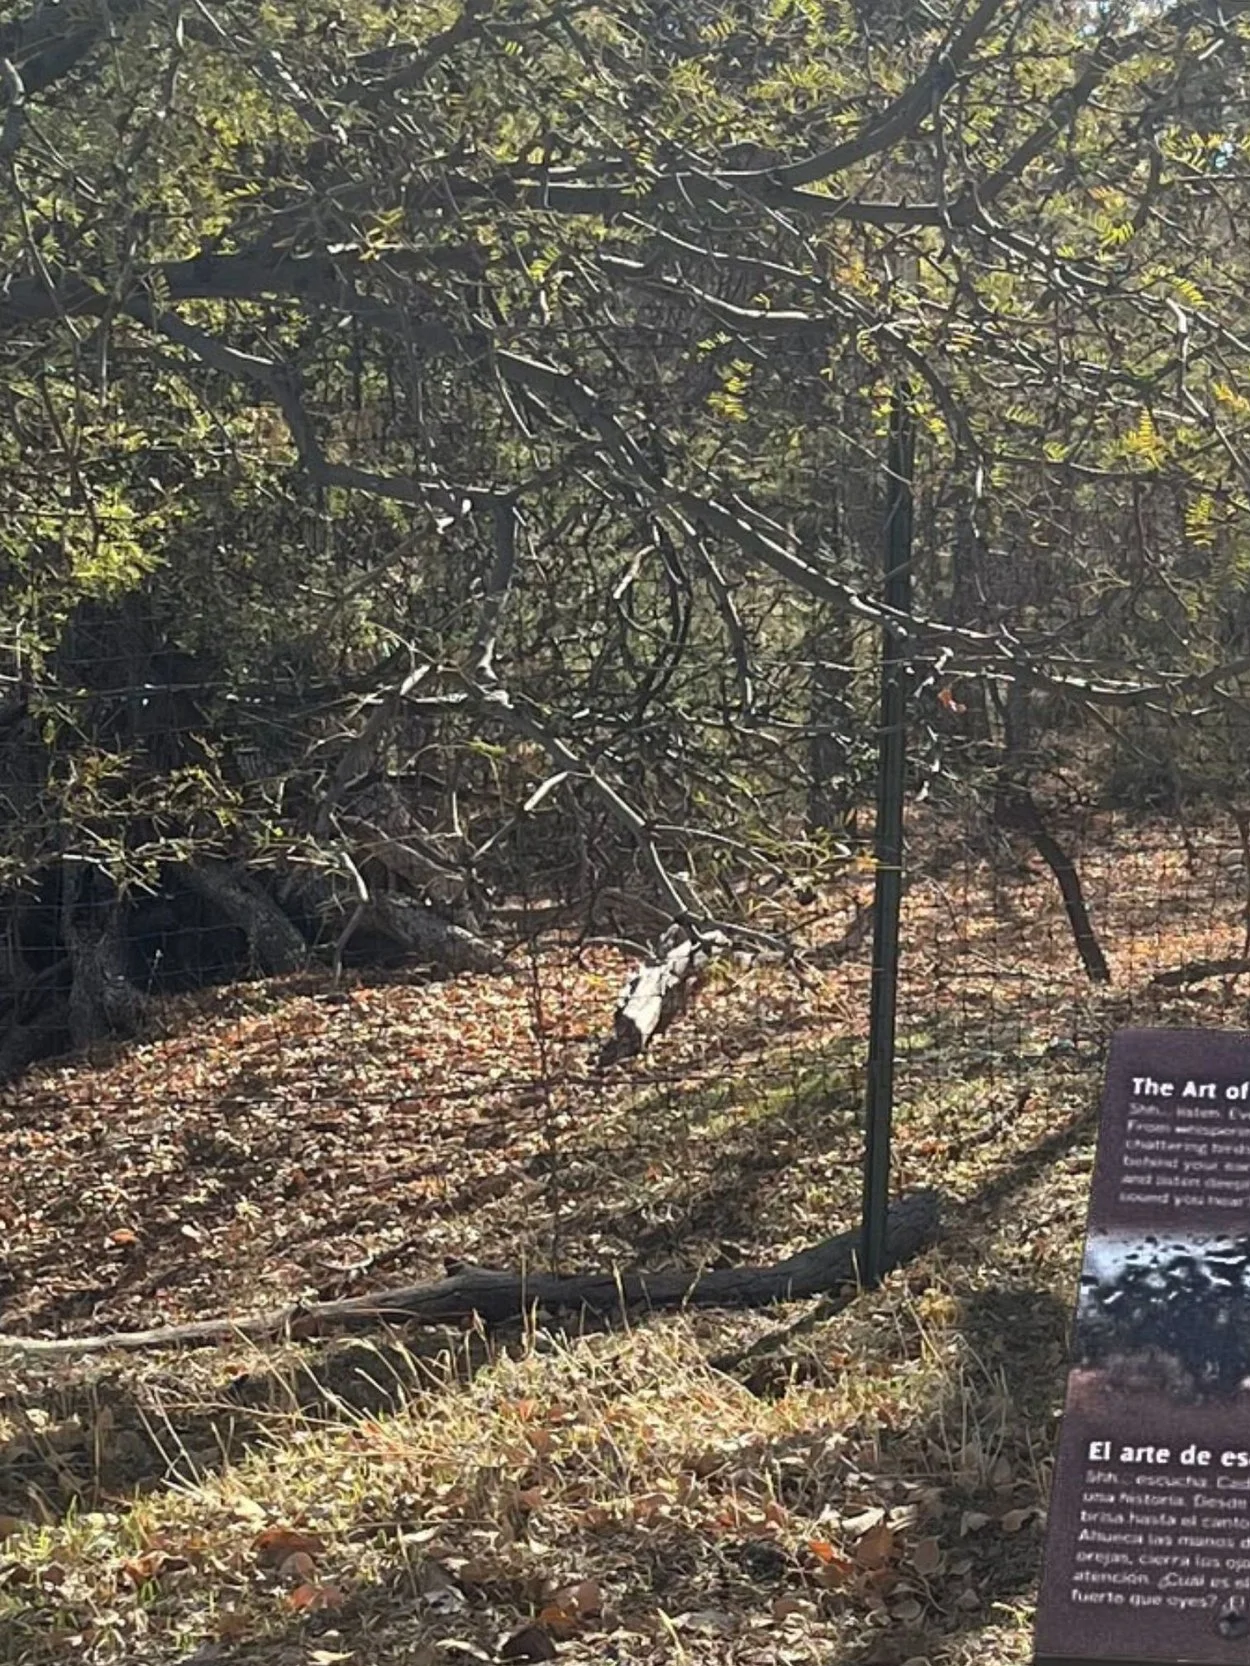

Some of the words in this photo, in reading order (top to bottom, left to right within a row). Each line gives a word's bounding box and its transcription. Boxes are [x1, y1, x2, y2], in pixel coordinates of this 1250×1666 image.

[1132, 1077, 1175, 1097] The
[1182, 1080, 1217, 1099] Art
[1225, 1081, 1250, 1100] of
[1088, 1440, 1112, 1461] El
[1119, 1445, 1171, 1464] arte
[1179, 1444, 1212, 1466] de
[1129, 1511, 1177, 1526] hasta
[1180, 1514, 1197, 1526] el
[1201, 1516, 1250, 1529] canto
[1129, 1593, 1163, 1608] que
